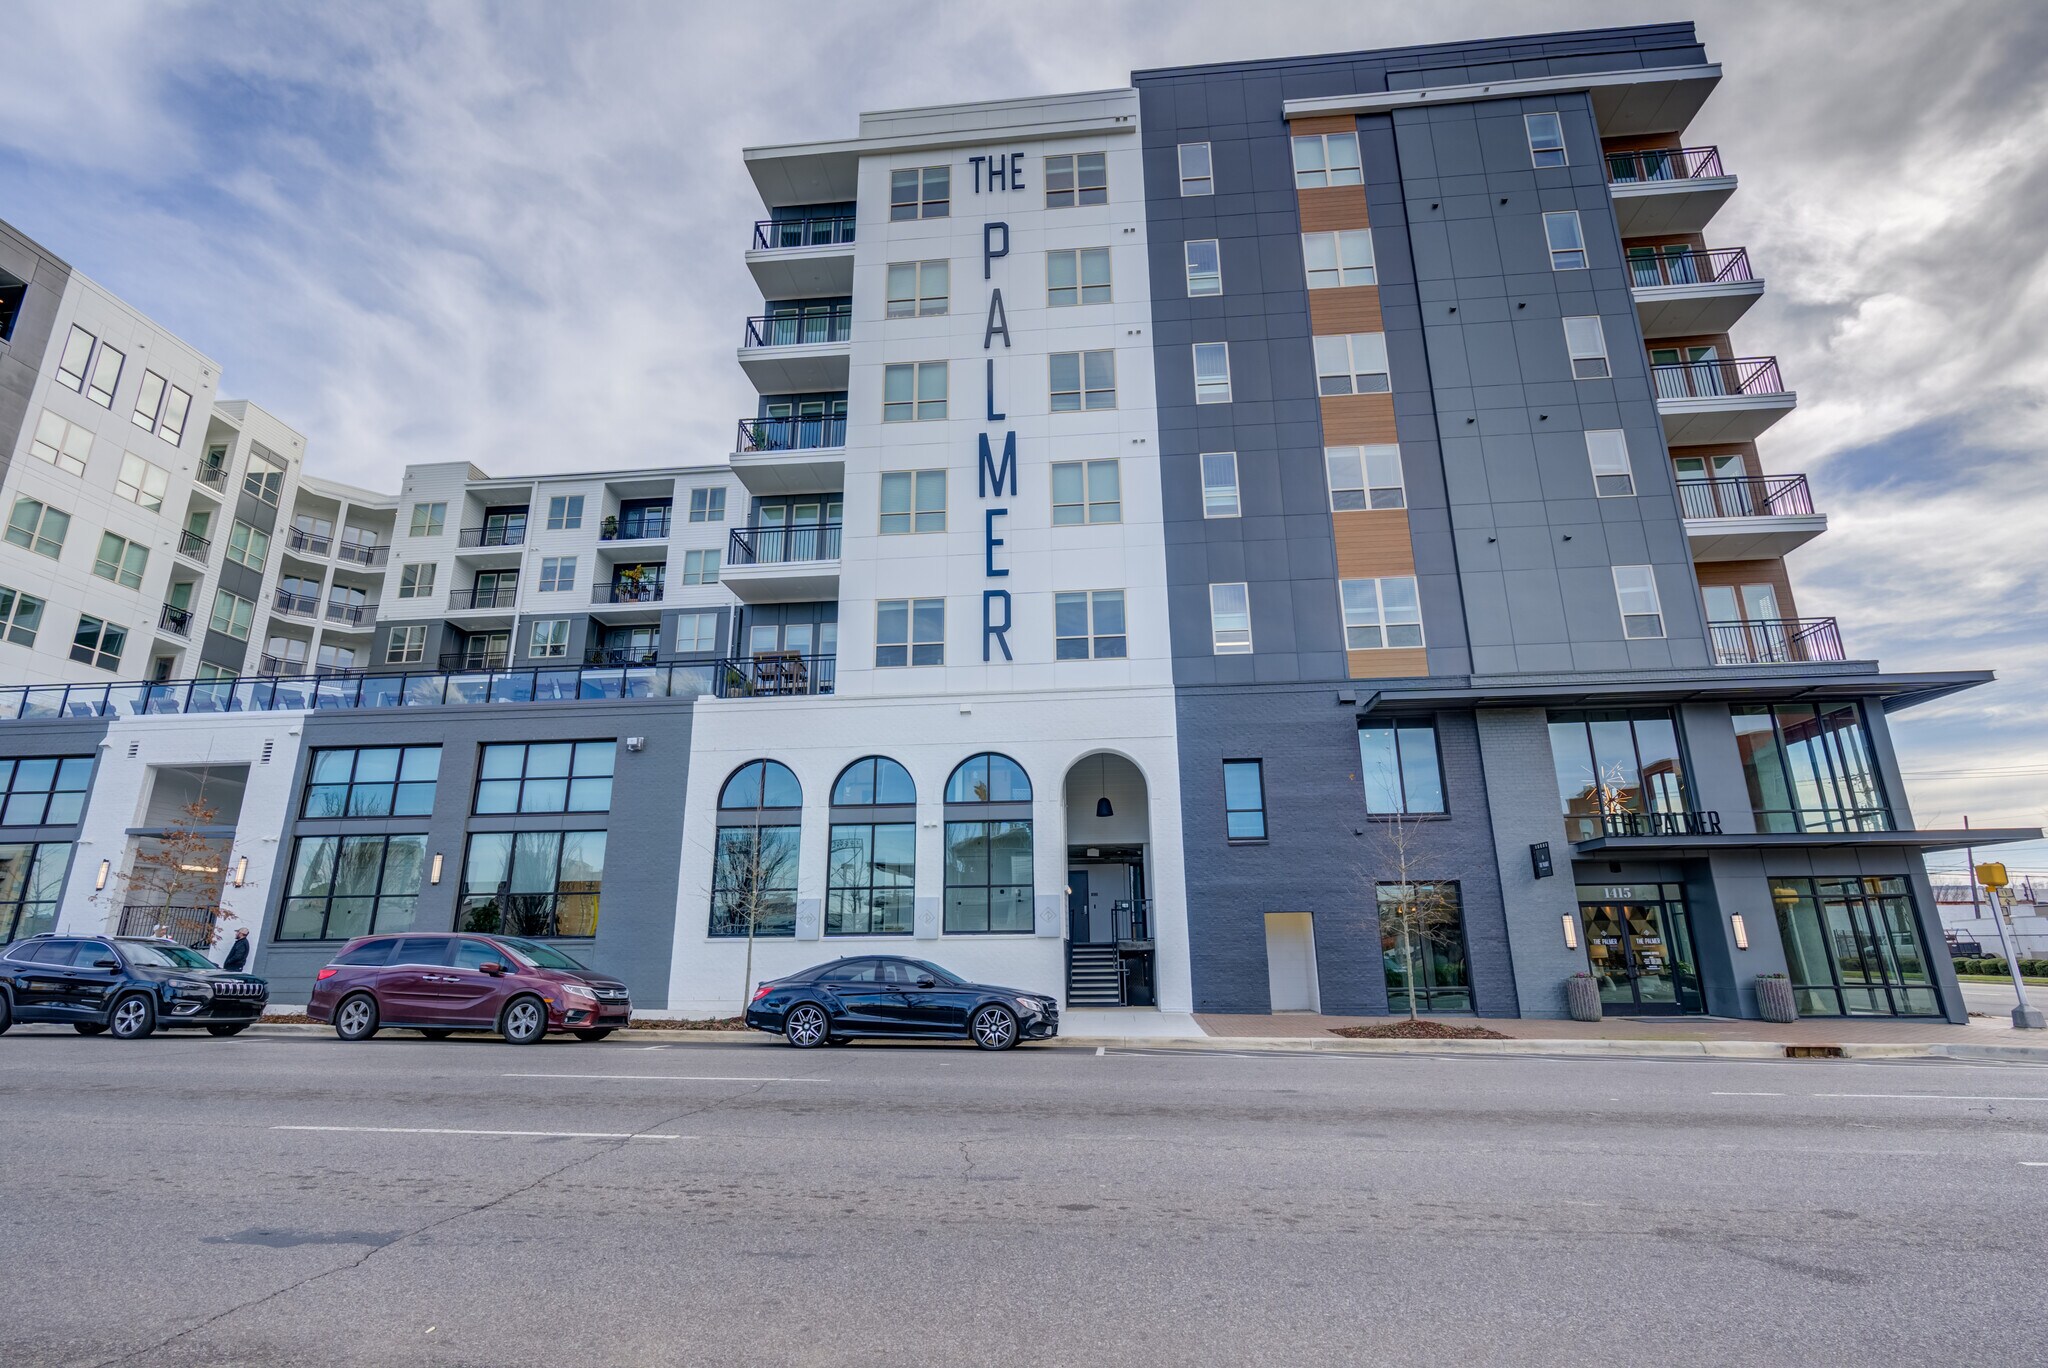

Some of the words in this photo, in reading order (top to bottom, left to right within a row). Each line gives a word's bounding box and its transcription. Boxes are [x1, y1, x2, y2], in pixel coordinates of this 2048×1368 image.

[969, 152, 1025, 193] THE
[979, 221, 1017, 661] PALMER
[1608, 812, 1644, 836] THE
[1651, 811, 1723, 836] PALMER
[1604, 888, 1632, 899] 1415
